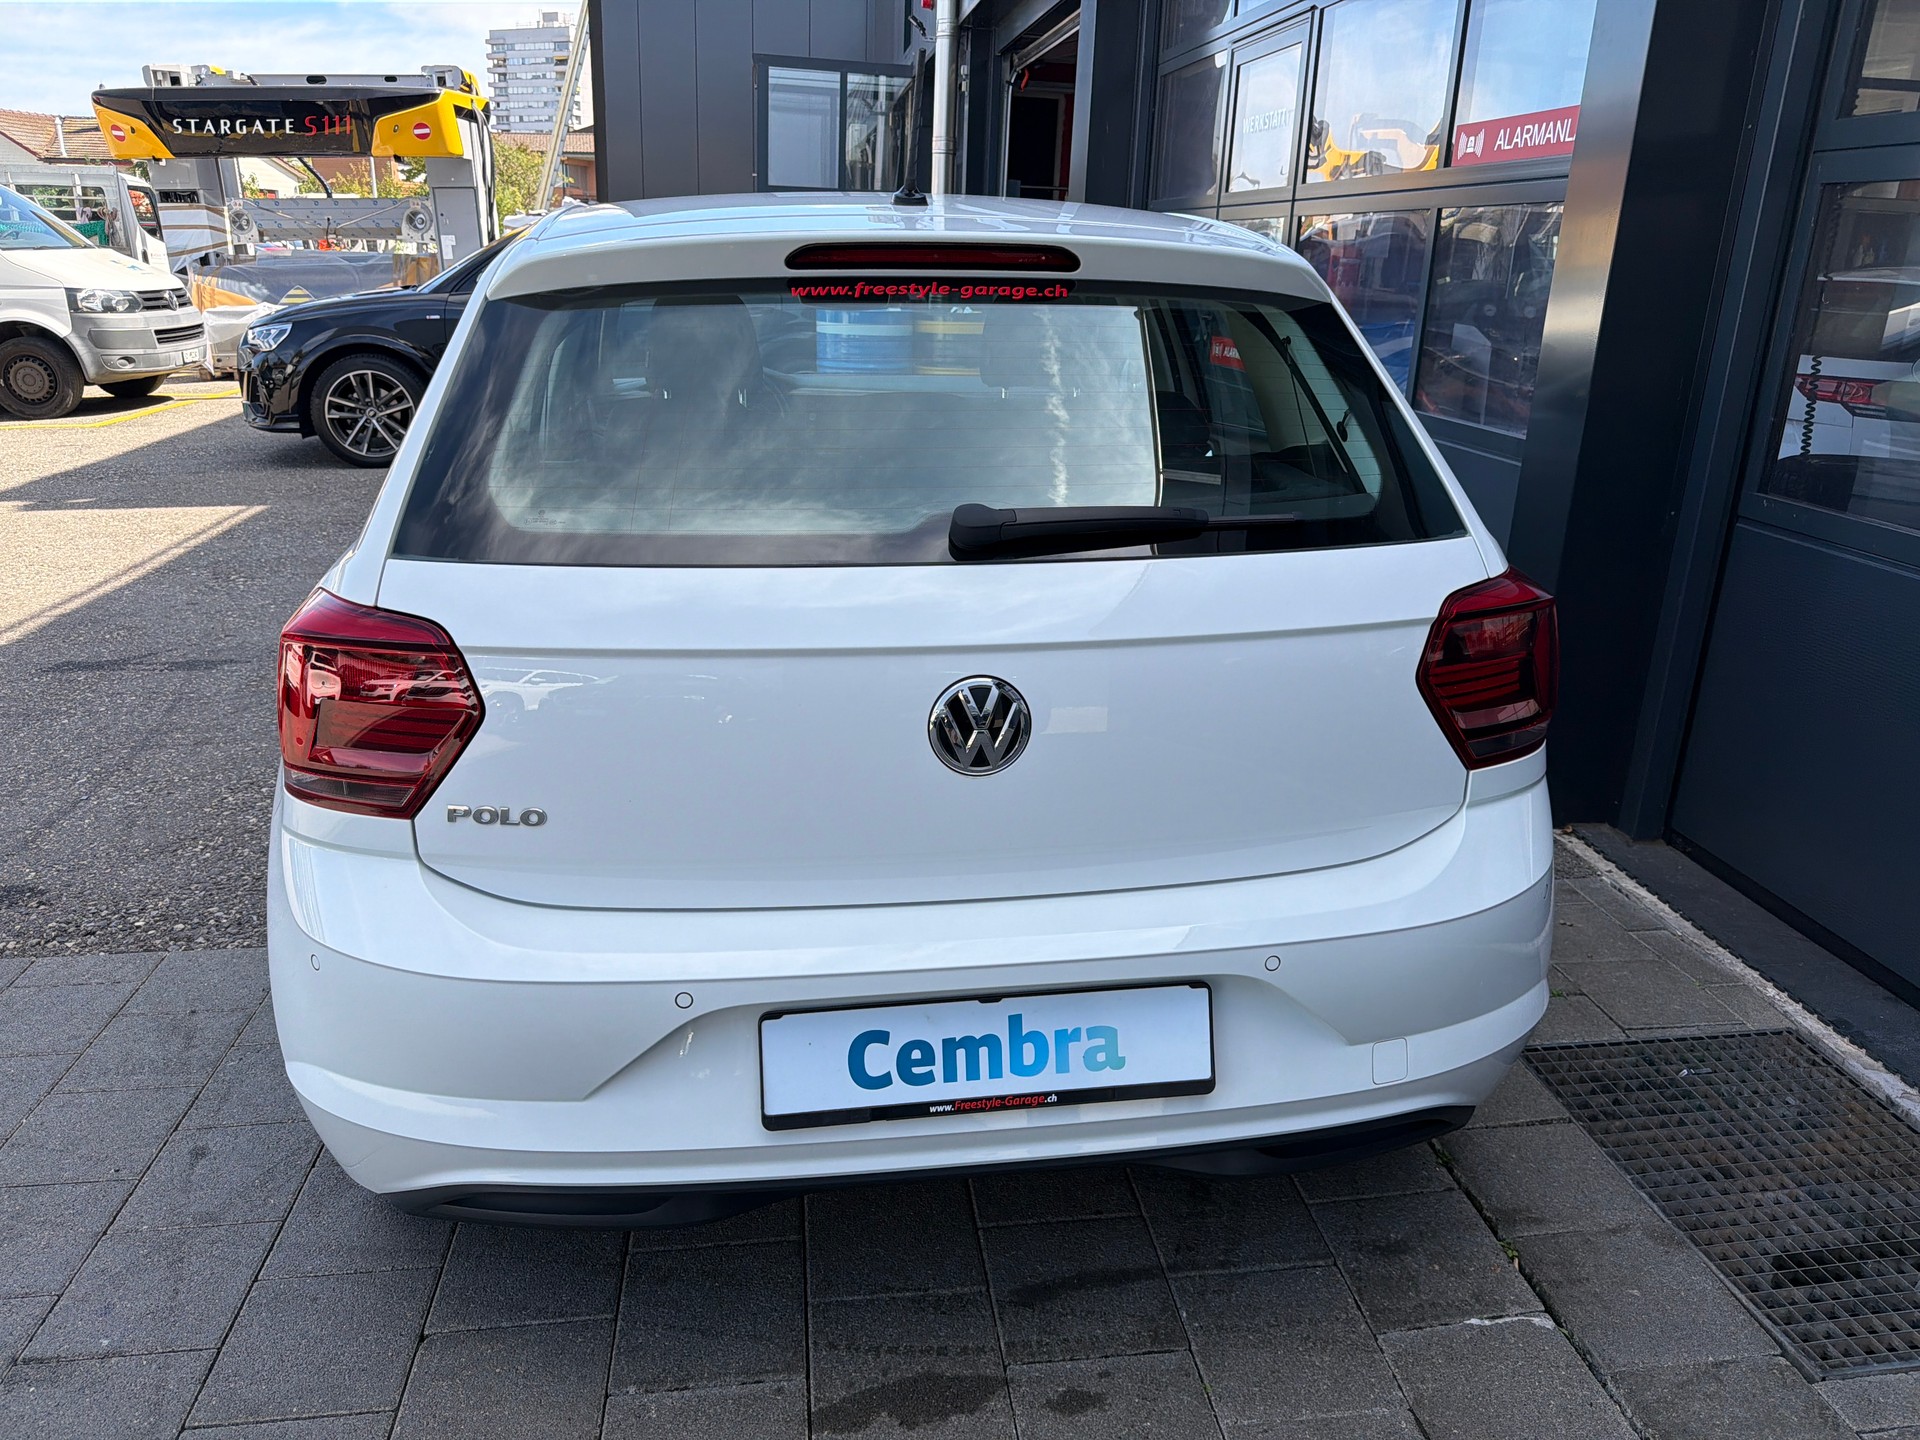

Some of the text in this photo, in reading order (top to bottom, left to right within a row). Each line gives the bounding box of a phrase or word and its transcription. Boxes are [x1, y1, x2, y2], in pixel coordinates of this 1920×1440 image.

[172, 115, 350, 136] STARGATE S111
[1493, 118, 1576, 151] ALARMANL
[791, 281, 1068, 299] www.freestyle-garage.ch
[931, 678, 1029, 774] VW
[447, 804, 548, 827] POLO
[847, 1013, 1126, 1090] Cembra
[929, 1093, 1058, 1113] www.Freestyle-Garage.ch
